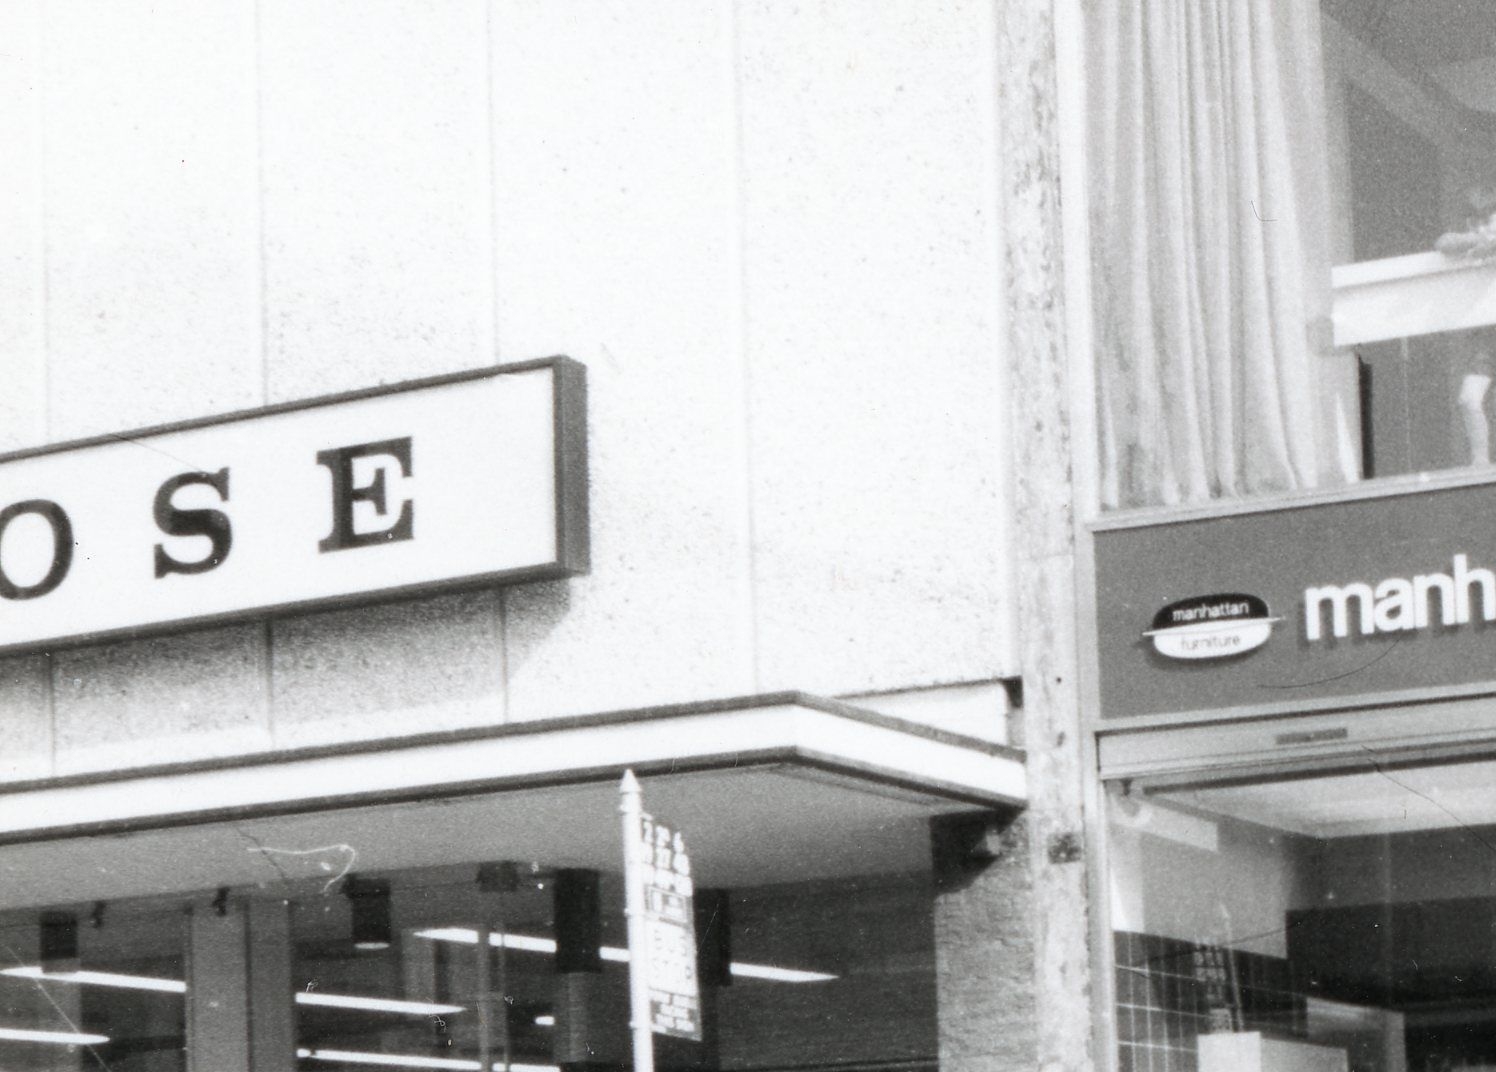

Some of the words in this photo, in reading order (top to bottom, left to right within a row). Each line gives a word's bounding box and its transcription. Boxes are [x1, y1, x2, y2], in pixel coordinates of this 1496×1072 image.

[0, 437, 413, 600] OSE
[1172, 603, 1249, 621] manhattan
[1181, 636, 1240, 650] furniture
